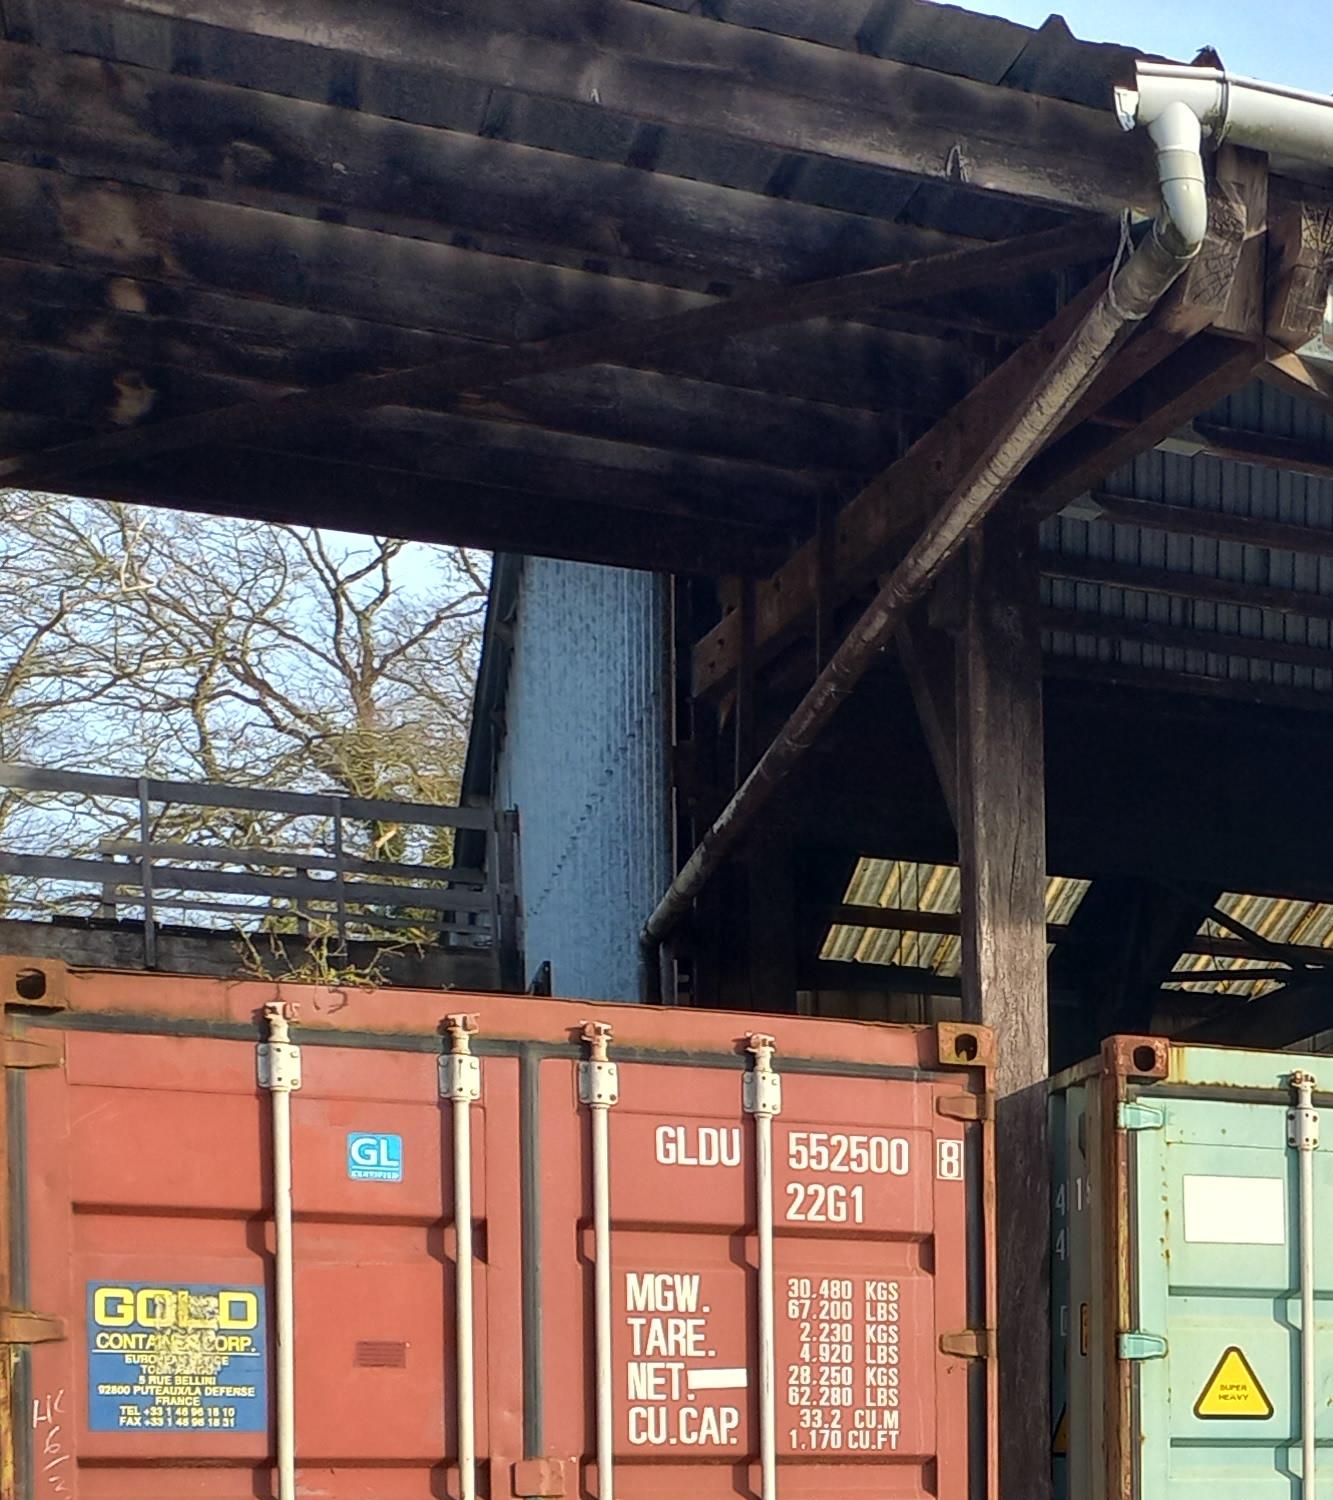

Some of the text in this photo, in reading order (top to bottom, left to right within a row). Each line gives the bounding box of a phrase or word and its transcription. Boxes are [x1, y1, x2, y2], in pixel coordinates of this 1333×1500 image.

[351, 1138, 399, 1166] GL
[655, 1126, 962, 1179] GLDU 552500 8
[786, 1182, 863, 1223] 22G1
[625, 1273, 899, 1313] MGW. 30.480 KGS
[94, 1287, 258, 1330] GOLD
[788, 1300, 899, 1322] 67.200 LBS
[203, 1334, 256, 1352] CORP.
[626, 1317, 899, 1357] TARE. 2.230 KGS
[799, 1344, 899, 1365] 4.920 LBS
[148, 1376, 172, 1385] RUE
[175, 1376, 216, 1386] BELLINI
[204, 1386, 255, 1397] DEFENSE
[627, 1361, 899, 1401] NET. 28.250 KGS
[155, 1396, 200, 1406] FRANCE
[788, 1386, 899, 1407] 62.280 LBS
[119, 1406, 140, 1416] TEL
[119, 1416, 142, 1427] FAX
[628, 1406, 899, 1445] CU.CAP. 33.2 CU.M
[789, 1430, 900, 1450] 1.170 CU.FT
